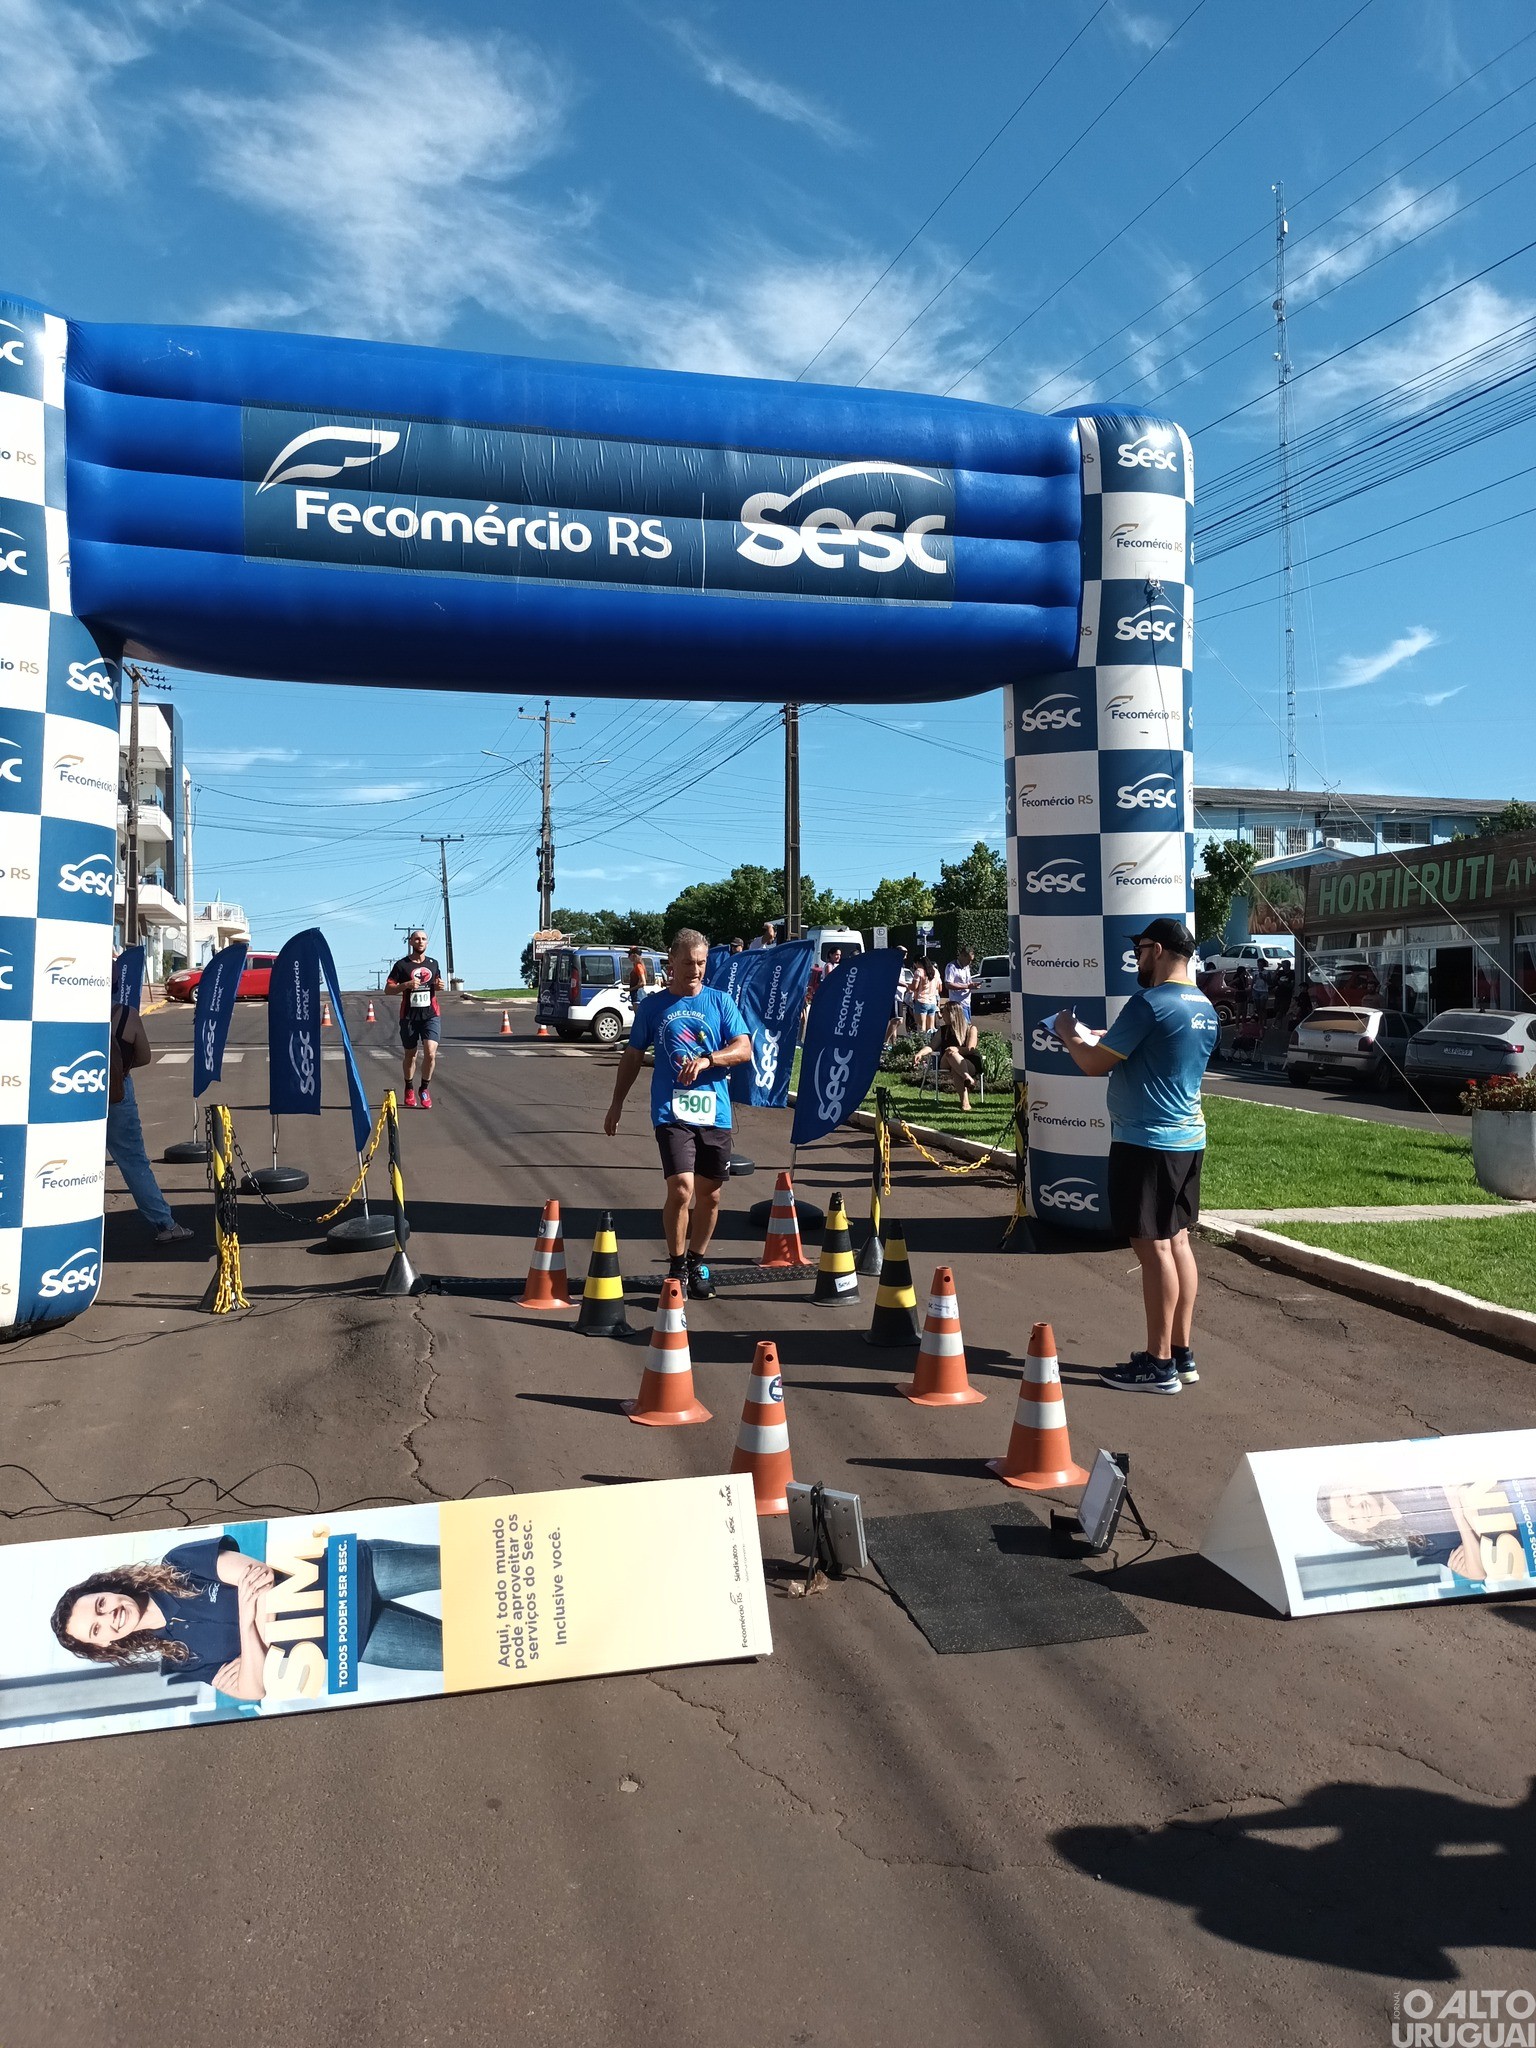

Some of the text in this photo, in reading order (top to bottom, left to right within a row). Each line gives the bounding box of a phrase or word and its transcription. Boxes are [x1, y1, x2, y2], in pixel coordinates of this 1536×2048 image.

[16, 450, 37, 466] RS
[1118, 436, 1177, 472] Sesc
[295, 489, 673, 559] Fecomércio RS
[736, 461, 948, 574] Sesc
[1116, 537, 1173, 550] Fecomércio
[1115, 604, 1176, 643] Sesc
[19, 660, 40, 675] RS
[1021, 693, 1082, 732] Sesc
[1111, 709, 1170, 721] Fecomércio
[60, 770, 113, 792] Fecomércio
[1116, 772, 1176, 809] Sesc
[1021, 796, 1075, 807] Fecomércio
[1078, 795, 1094, 805] RS
[10, 867, 31, 881] RS
[1025, 857, 1086, 893] Sesc
[1115, 875, 1172, 886] Fecomércio
[1318, 854, 1495, 916] HORTIFRUTI
[51, 973, 106, 987] Fecomércio
[727, 961, 738, 996] omércio
[1026, 956, 1080, 968] Fecomércio
[1083, 957, 1099, 968] RS
[293, 960, 302, 1021] Fecomércio
[412, 993, 429, 1003] 410
[764, 965, 782, 1020] Fecomércio
[777, 991, 789, 1020] Senac
[834, 966, 858, 1036] Fecomércio
[667, 1009, 682, 1021] QUE
[848, 1000, 865, 1037] Senac
[49, 1050, 107, 1095] Sesc
[289, 1031, 314, 1097] Sesc
[750, 1028, 782, 1091] Sesc
[1, 1075, 22, 1087] RS
[814, 1047, 853, 1124] Sesc
[678, 1094, 712, 1114] 590
[1033, 1113, 1106, 1128] Fecomércio RS
[42, 1174, 98, 1190] Fecomércio
[1039, 1177, 1099, 1212] Sesc
[1135, 1373, 1156, 1383] FILA
[732, 1544, 741, 1582] Sindicatos
[493, 1518, 511, 1667] Aqui, todo mundo
[508, 1513, 527, 1669] pode aproveitar os
[522, 1519, 539, 1660] serviços do Sesc.
[548, 1527, 567, 1645] Inclusive você.
[338, 1540, 348, 1688] TODOS PODEM SER SESC.
[737, 1604, 748, 1648] Fecomércio
